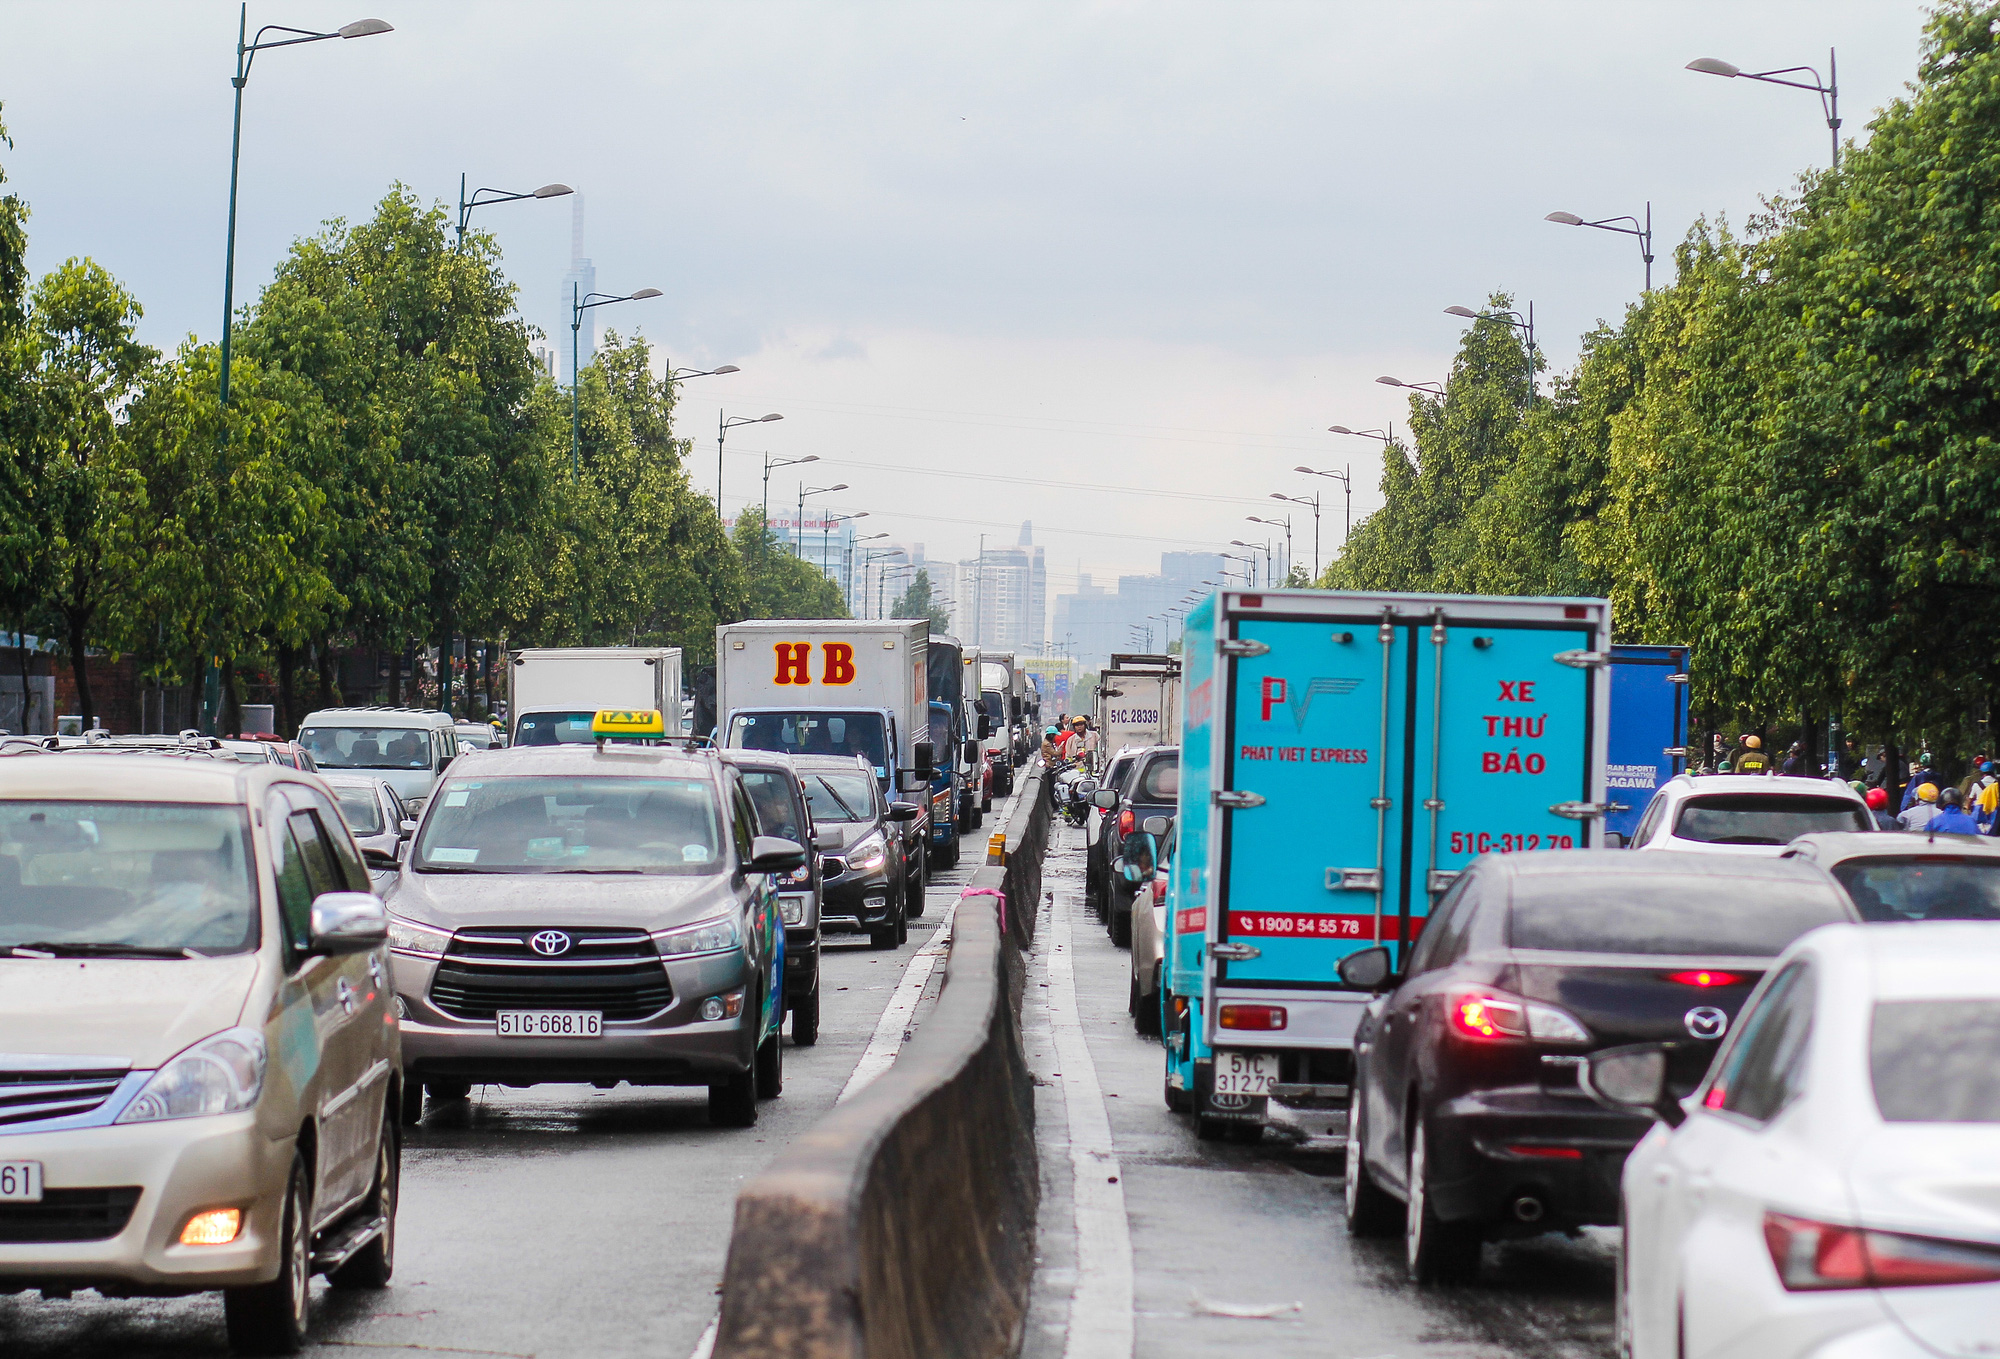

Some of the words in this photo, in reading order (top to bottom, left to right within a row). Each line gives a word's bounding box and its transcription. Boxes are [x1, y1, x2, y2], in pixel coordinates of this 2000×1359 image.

[1498, 680, 1536, 702] XE
[1482, 713, 1548, 738] THƯ
[1241, 746, 1275, 761] PHAT
[1278, 747, 1307, 762] VIET
[1311, 748, 1369, 764] EXPRESS
[1482, 747, 1547, 775] BÁO
[1258, 917, 1294, 932] 1900
[1296, 918, 1316, 932] 54
[1318, 919, 1338, 934] 55
[1341, 920, 1360, 934] 78
[500, 1014, 598, 1033] 51G-668.16
[1231, 1054, 1265, 1074] 51C
[1216, 1094, 1244, 1105] KIA
